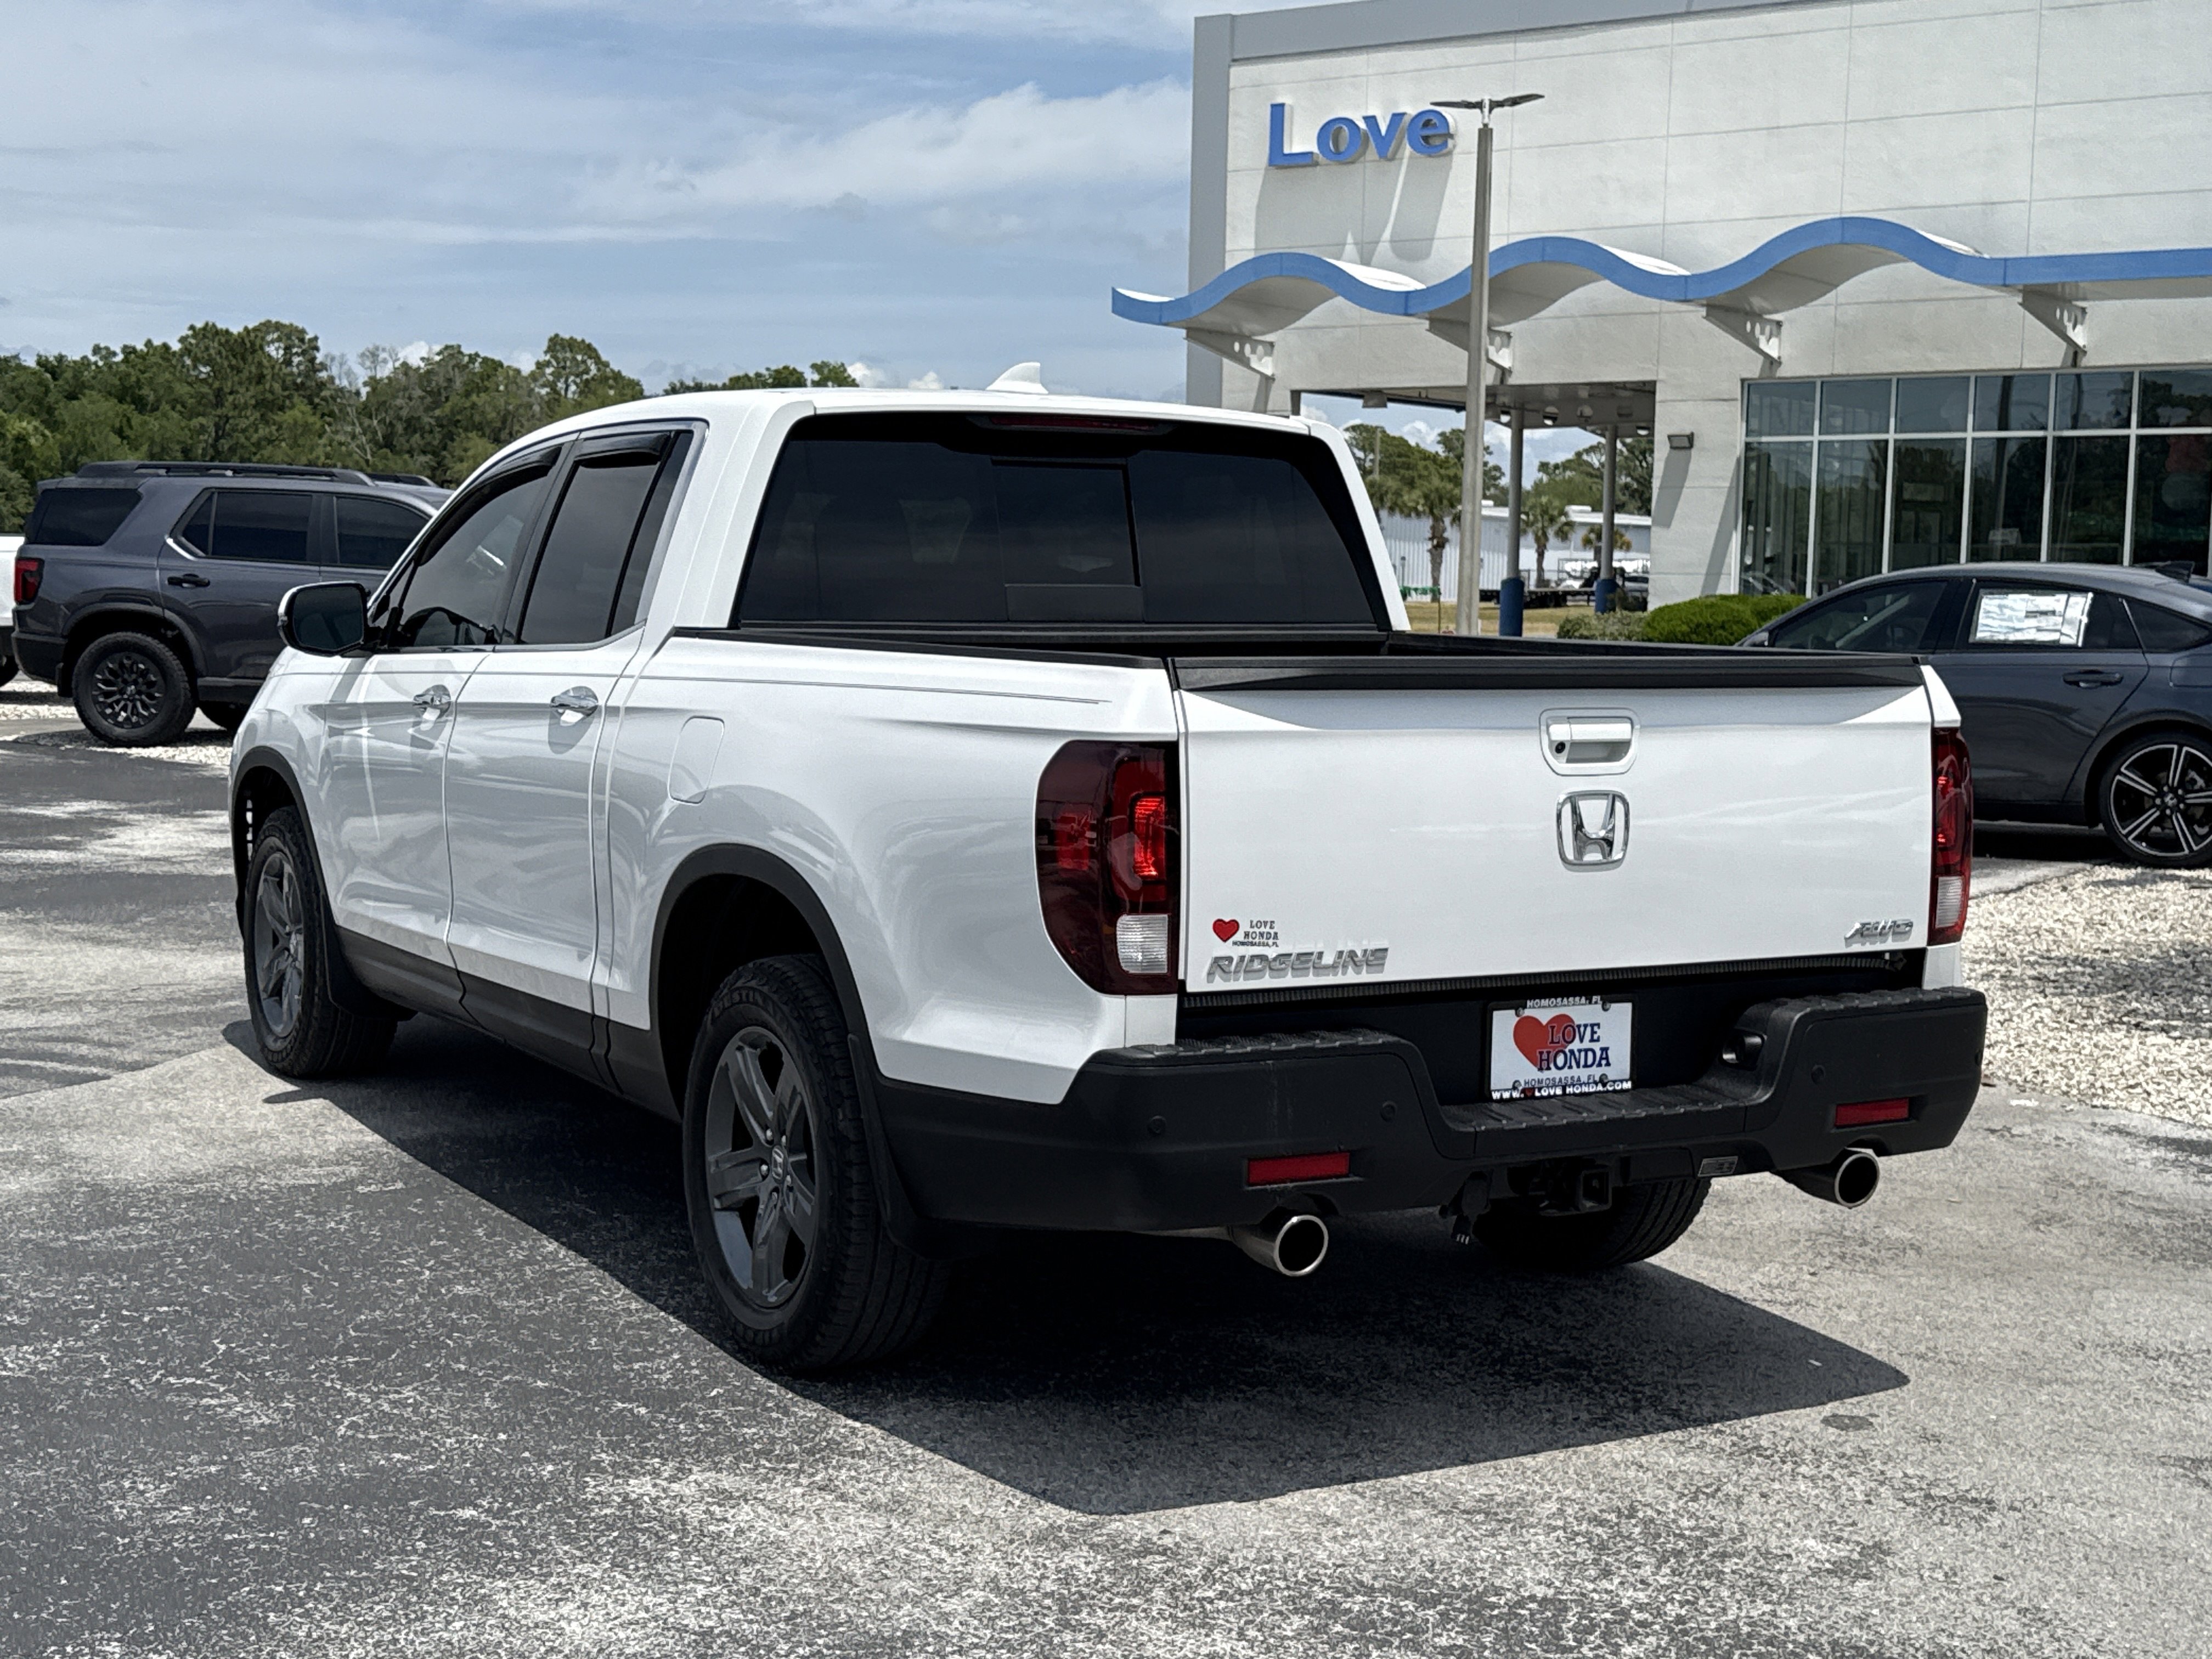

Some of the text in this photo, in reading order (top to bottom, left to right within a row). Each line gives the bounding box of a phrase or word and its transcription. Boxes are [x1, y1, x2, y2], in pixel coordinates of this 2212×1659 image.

[1268, 102, 1456, 166] Love
[1250, 919, 1276, 929] LOVE
[1244, 931, 1279, 940] HONDA
[1844, 918, 1914, 947] AWD
[1205, 947, 1389, 983] RIDGELINE
[1592, 995, 1602, 1004] FL
[1549, 1023, 1600, 1045] LOVE
[1537, 1047, 1611, 1072] HONDA
[1587, 1074, 1596, 1083] FL
[1534, 1086, 1562, 1096] LOVE
